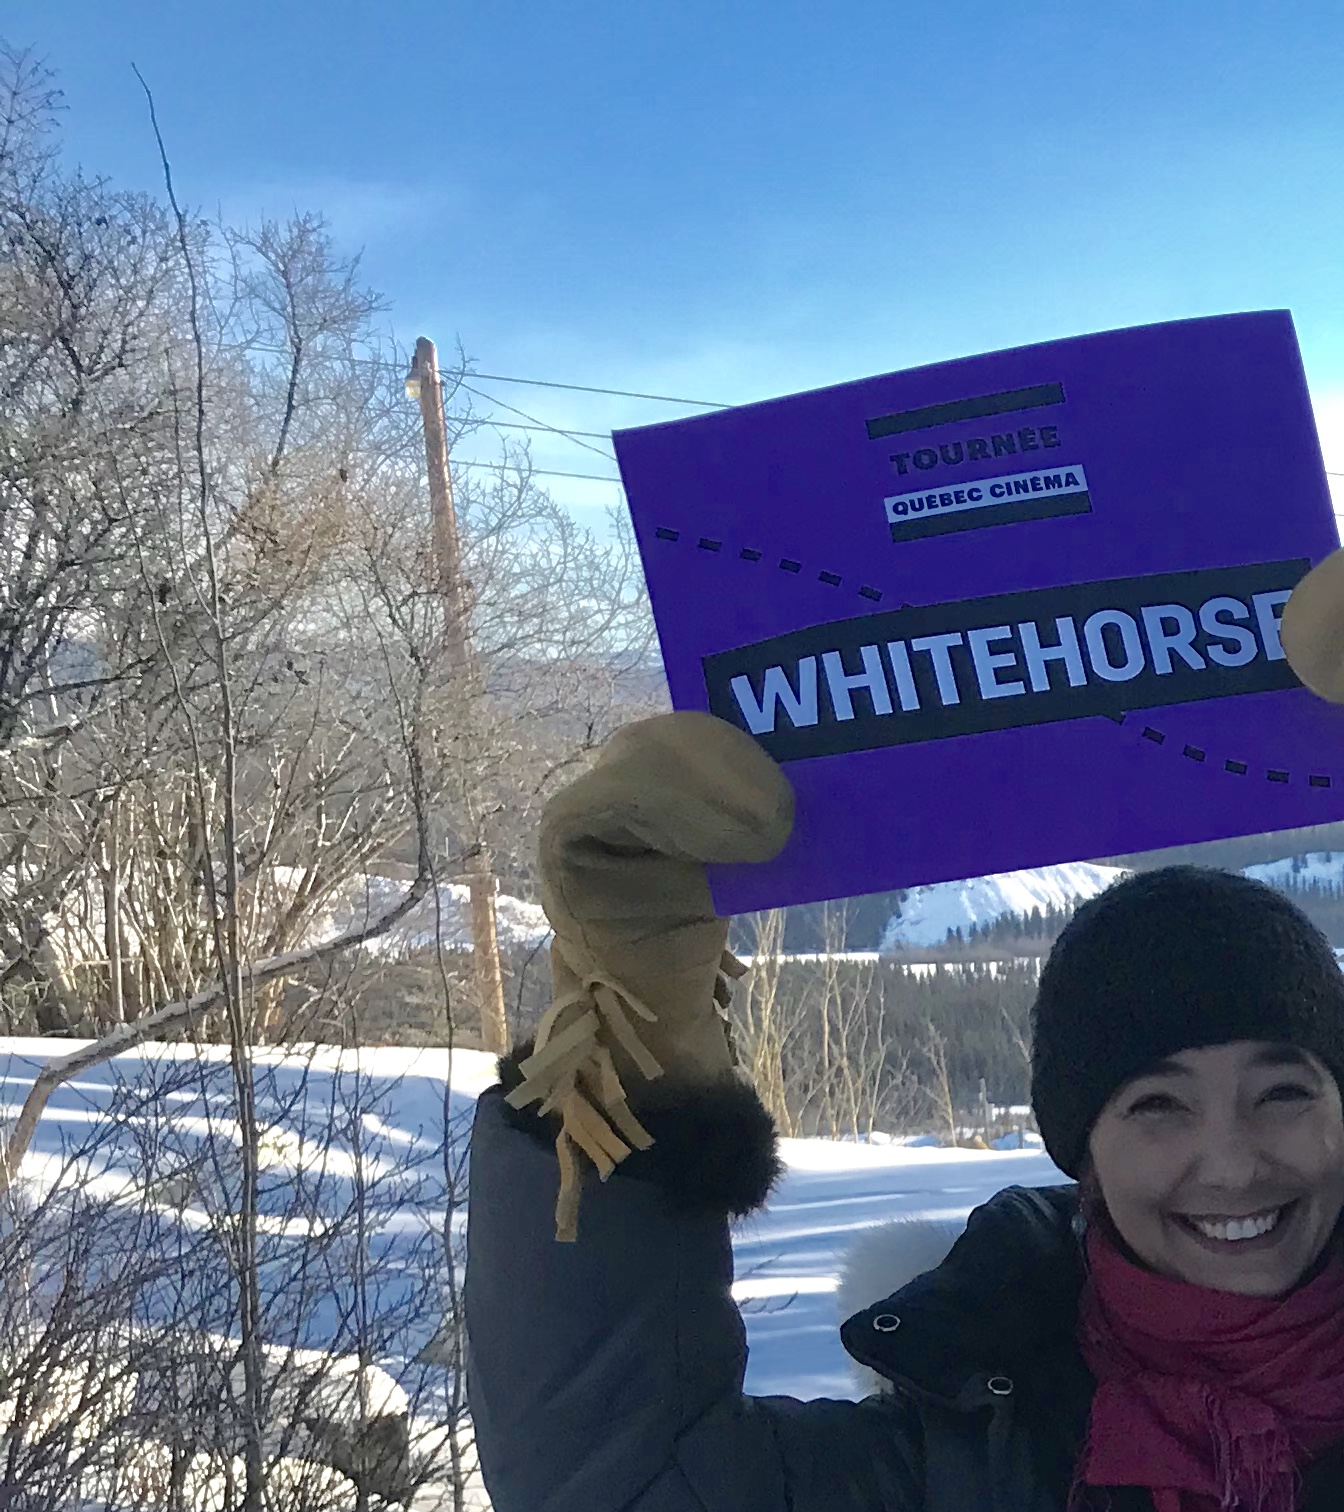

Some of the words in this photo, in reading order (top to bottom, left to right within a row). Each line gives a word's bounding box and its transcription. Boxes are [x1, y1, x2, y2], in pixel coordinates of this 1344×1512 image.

[889, 425, 1062, 475] TOURNÉE
[892, 487, 983, 516] QUÉBEC
[989, 472, 1080, 499] CINÉMA
